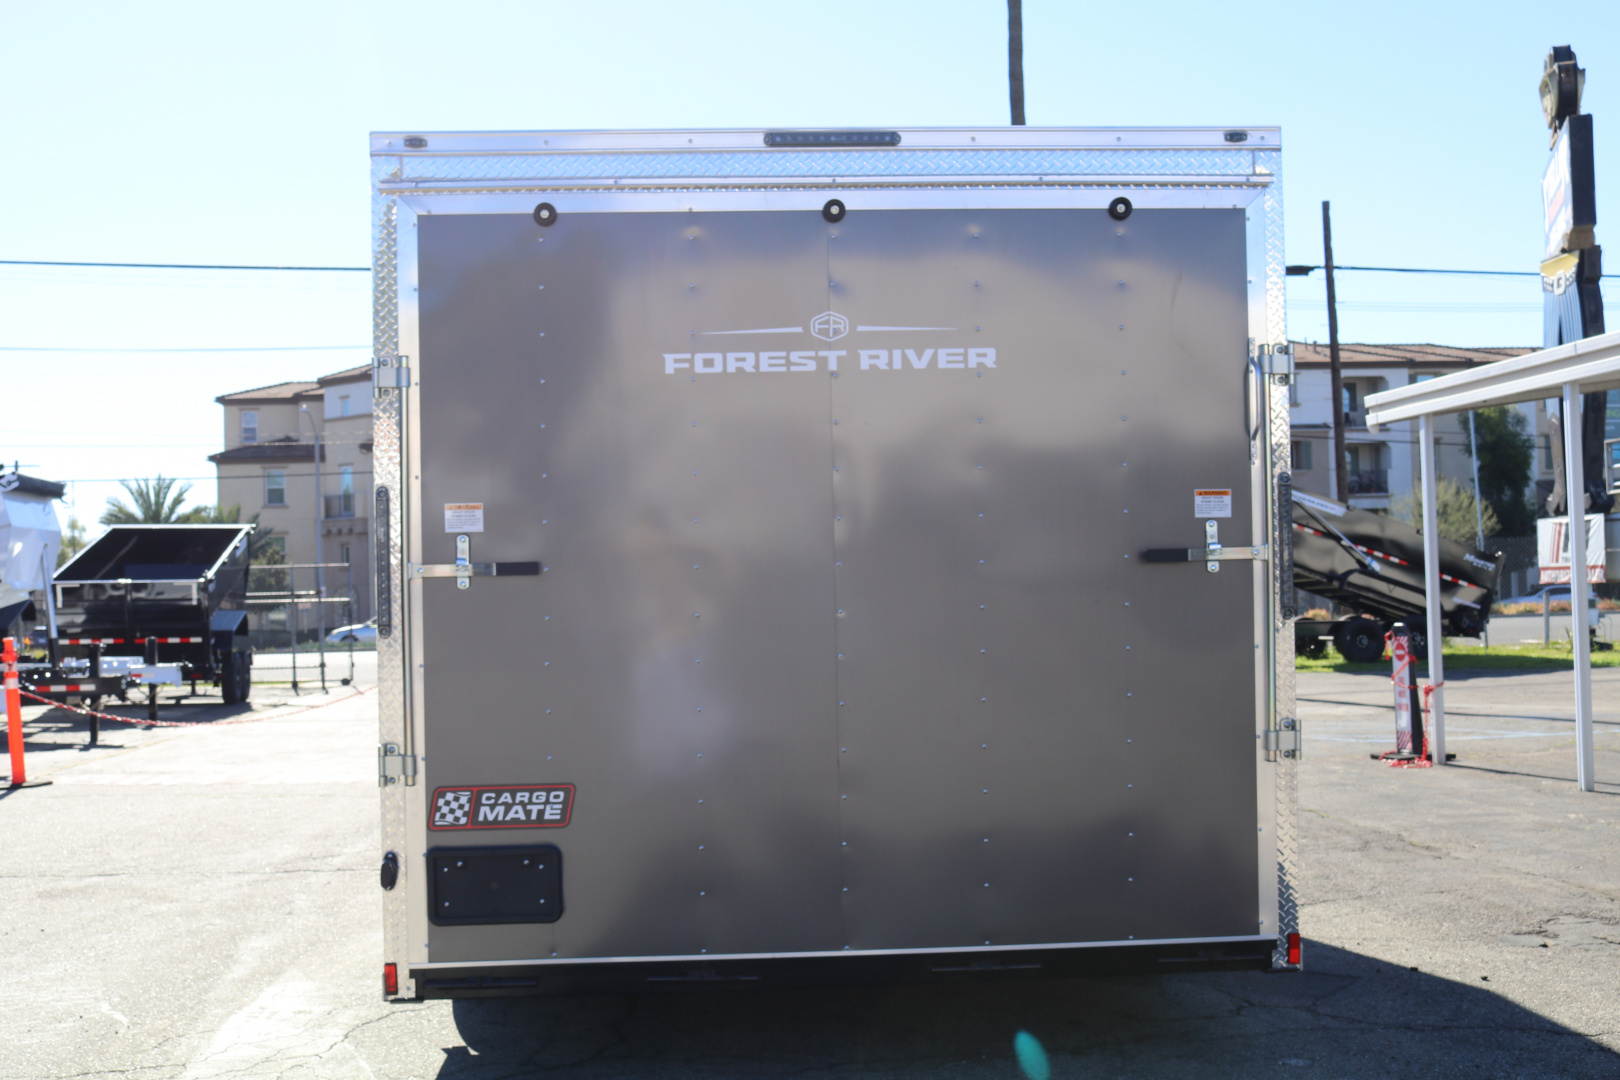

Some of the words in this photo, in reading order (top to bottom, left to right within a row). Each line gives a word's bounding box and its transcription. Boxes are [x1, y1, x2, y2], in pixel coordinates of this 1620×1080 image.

[662, 350, 847, 374] FOREST
[858, 347, 998, 370] RIVER
[481, 791, 565, 804] CARGO
[478, 804, 563, 821] MATE
